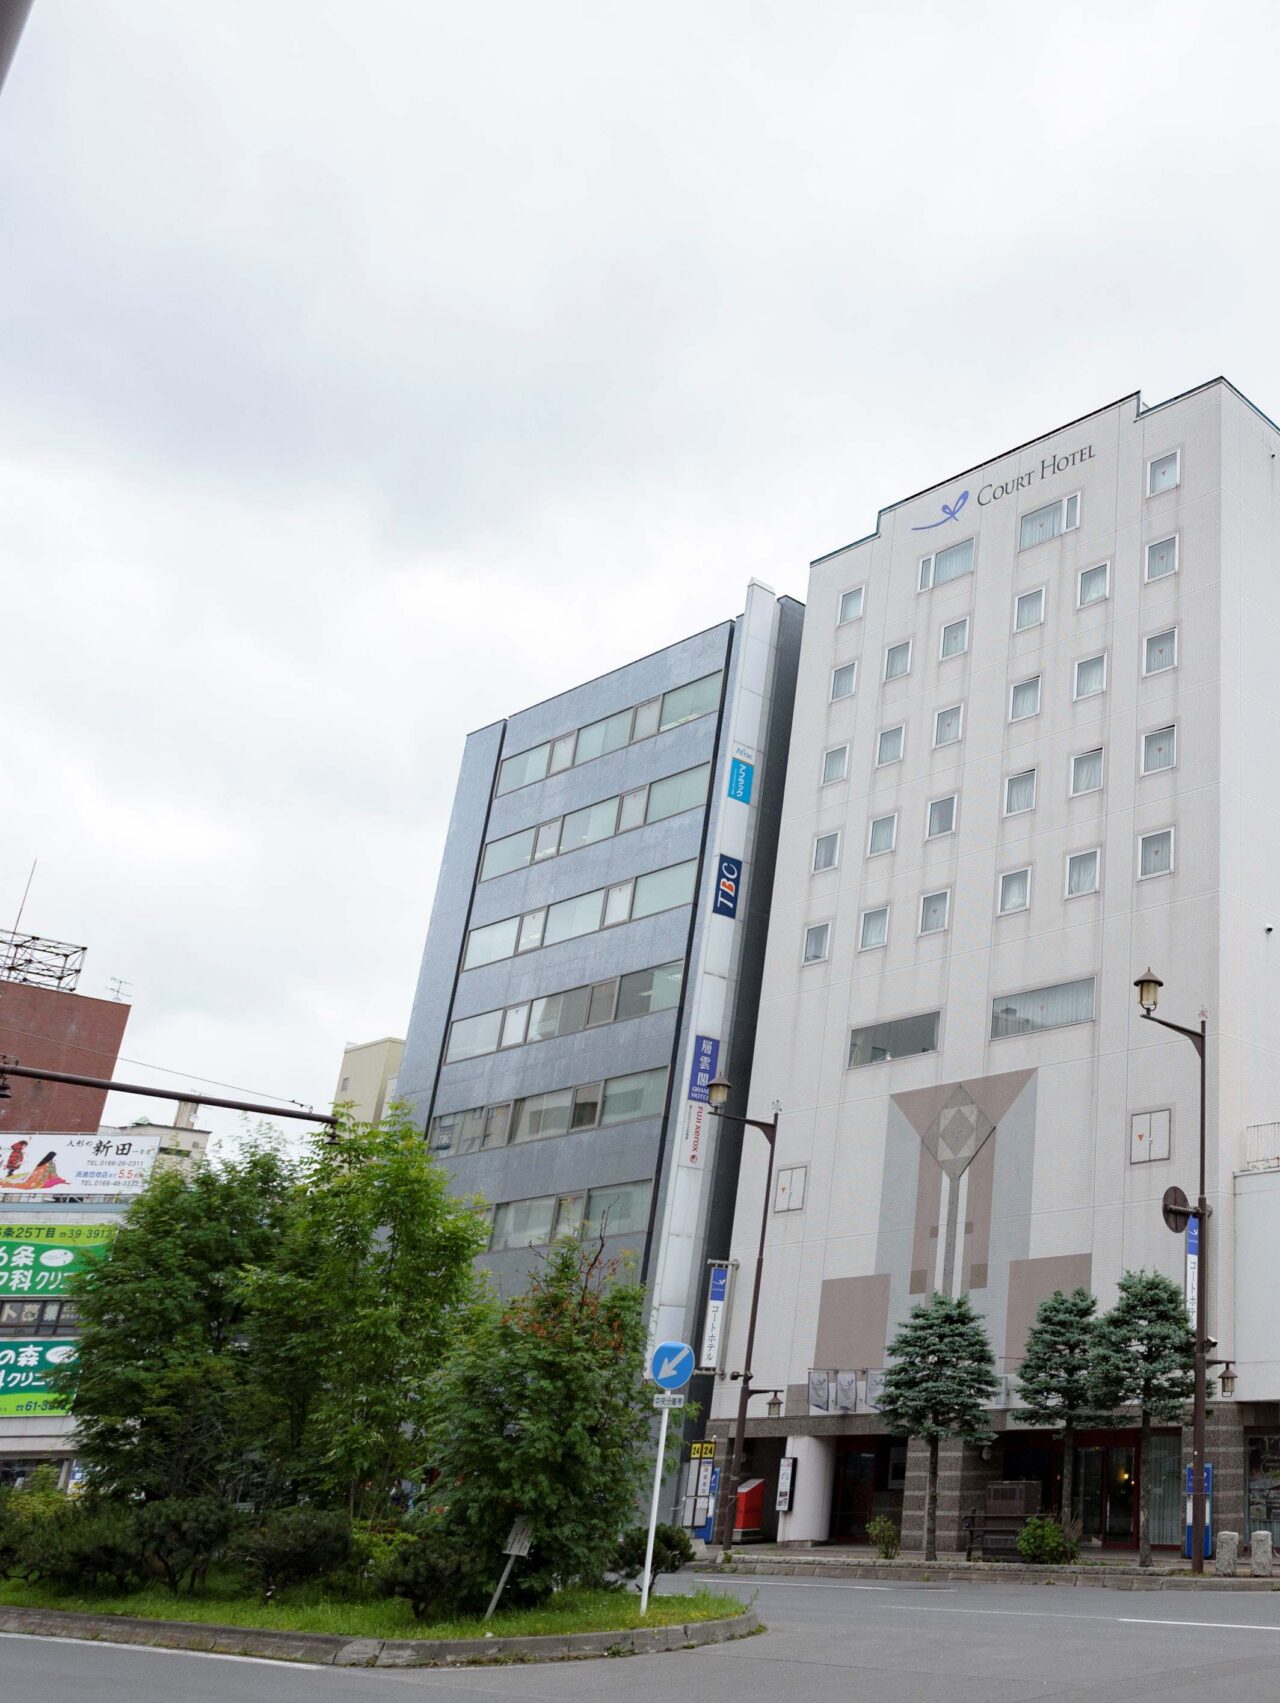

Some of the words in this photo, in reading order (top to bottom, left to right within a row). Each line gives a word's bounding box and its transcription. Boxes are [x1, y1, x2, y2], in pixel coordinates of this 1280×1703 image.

[717, 862, 738, 909] TBC
[706, 1305, 719, 1361] コートホテル
[692, 1446, 700, 1456] 24
[703, 1445, 713, 1454] 24
